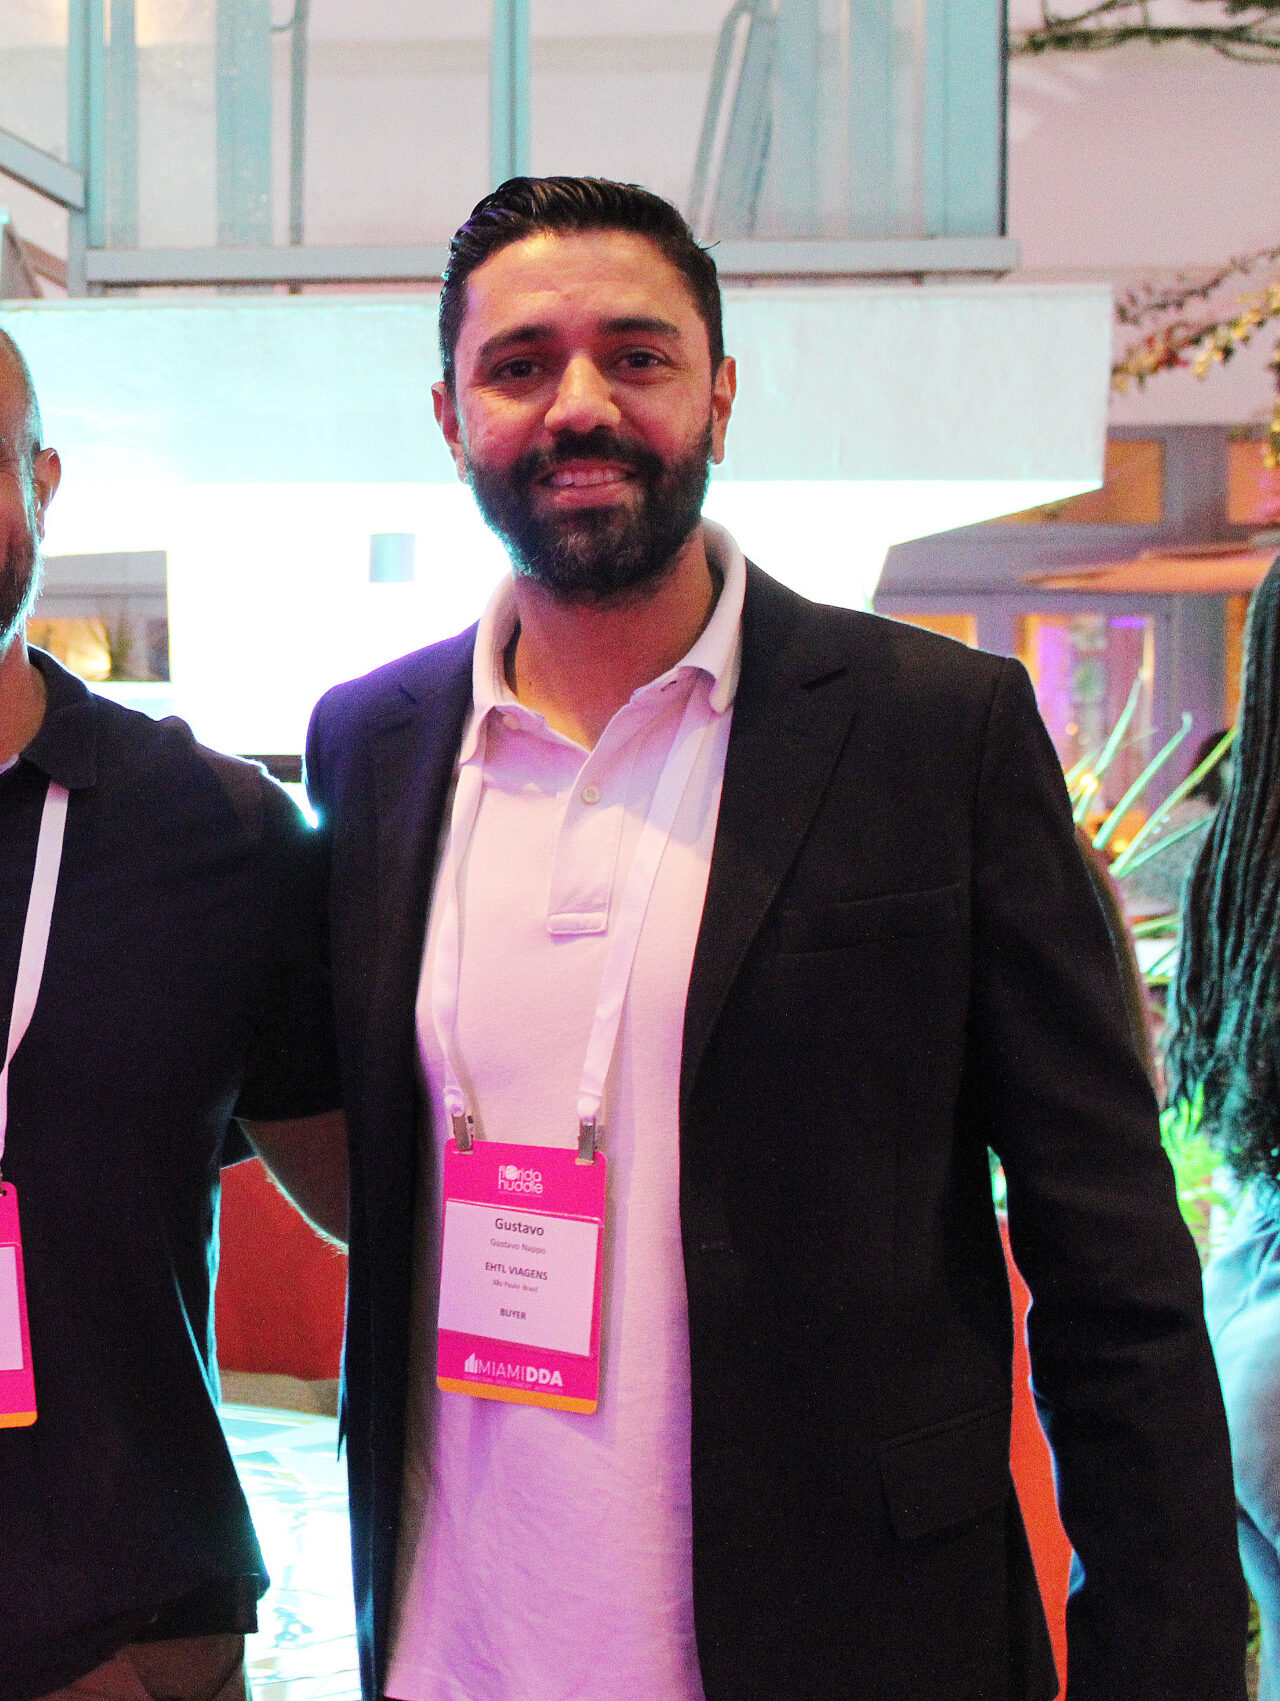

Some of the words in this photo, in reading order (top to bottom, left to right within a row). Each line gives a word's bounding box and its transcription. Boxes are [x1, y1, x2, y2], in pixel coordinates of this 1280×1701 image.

[498, 1165, 542, 1184] florida
[498, 1179, 543, 1194] huddle
[494, 1217, 545, 1236] Gustavo
[485, 1261, 507, 1274] EHTL
[508, 1265, 548, 1281] VIAGENS
[499, 1307, 527, 1320] BUYER
[478, 1359, 563, 1387] MIAMIDDA
